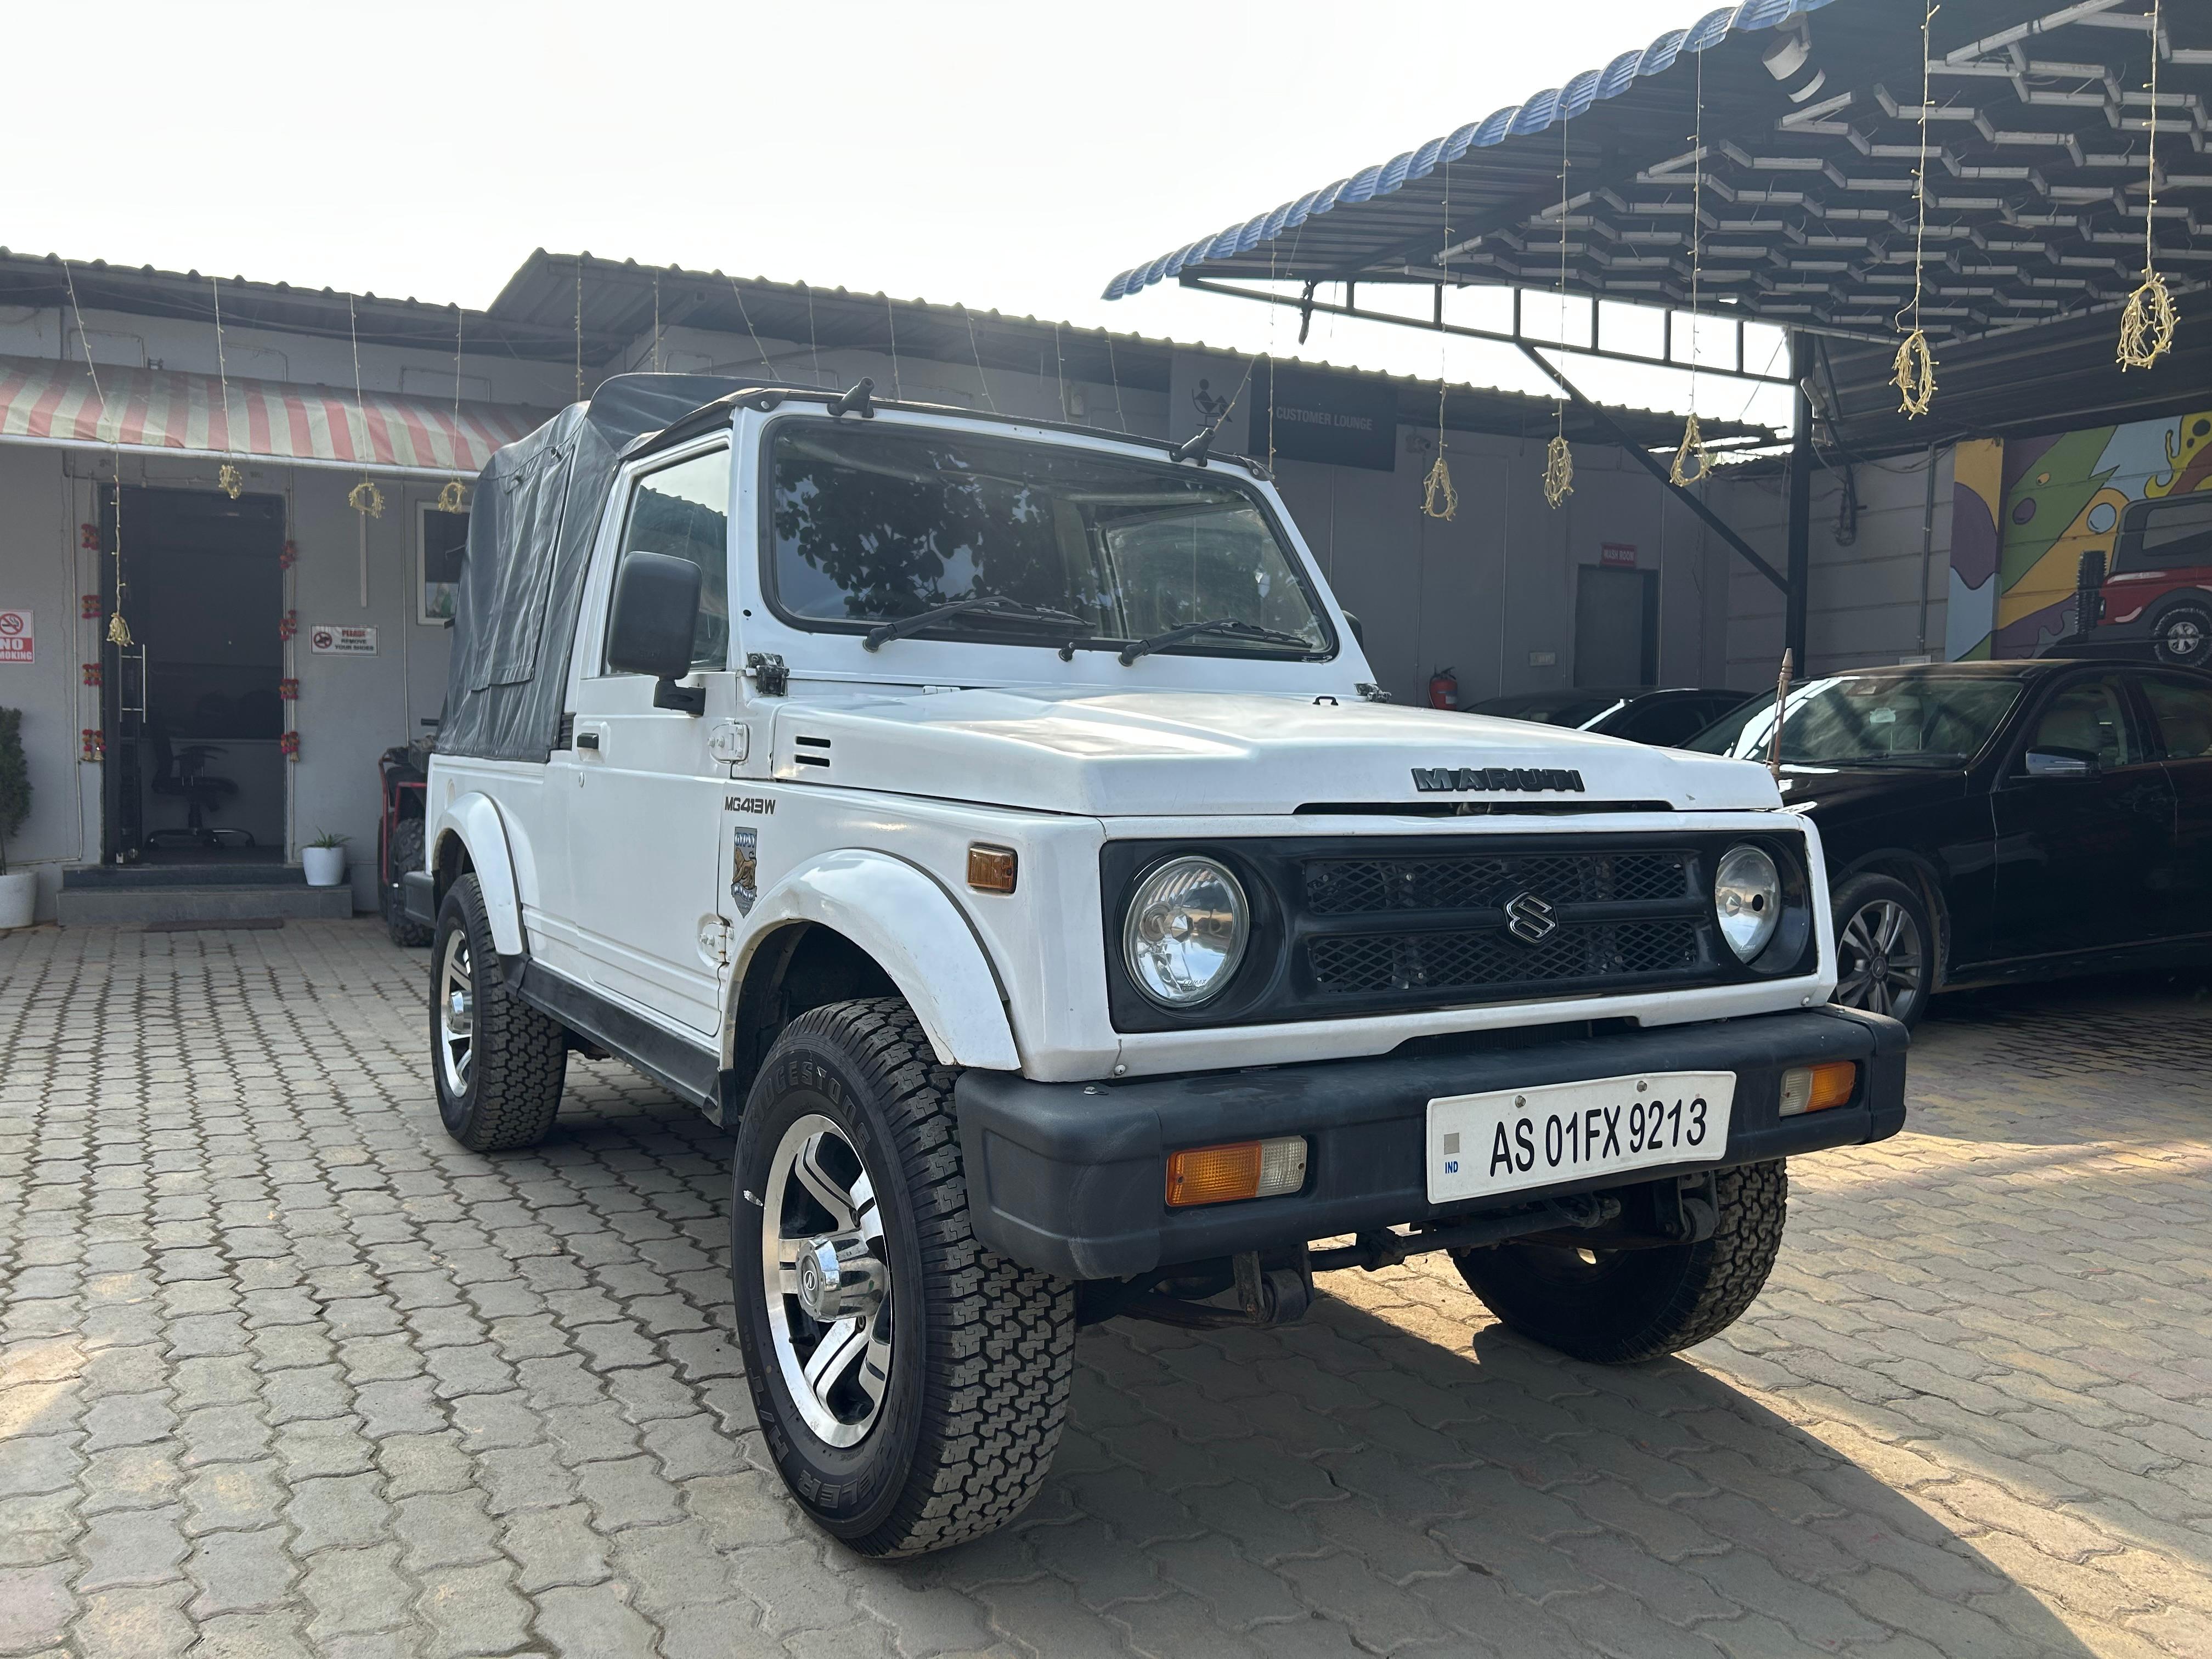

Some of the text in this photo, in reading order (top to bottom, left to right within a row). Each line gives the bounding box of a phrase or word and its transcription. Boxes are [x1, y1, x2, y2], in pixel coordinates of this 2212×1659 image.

[1276, 407, 1373, 431] CUSTOMER LOUNGE
[0, 638, 24, 650] NO
[0, 651, 32, 661] MOKING
[1411, 768, 1585, 792] MARUTI
[724, 795, 776, 815] MG413W
[734, 832, 756, 849] GYPSY
[1490, 1097, 1707, 1177] AS 01FX 9213
[1444, 1160, 1458, 1174] IND
